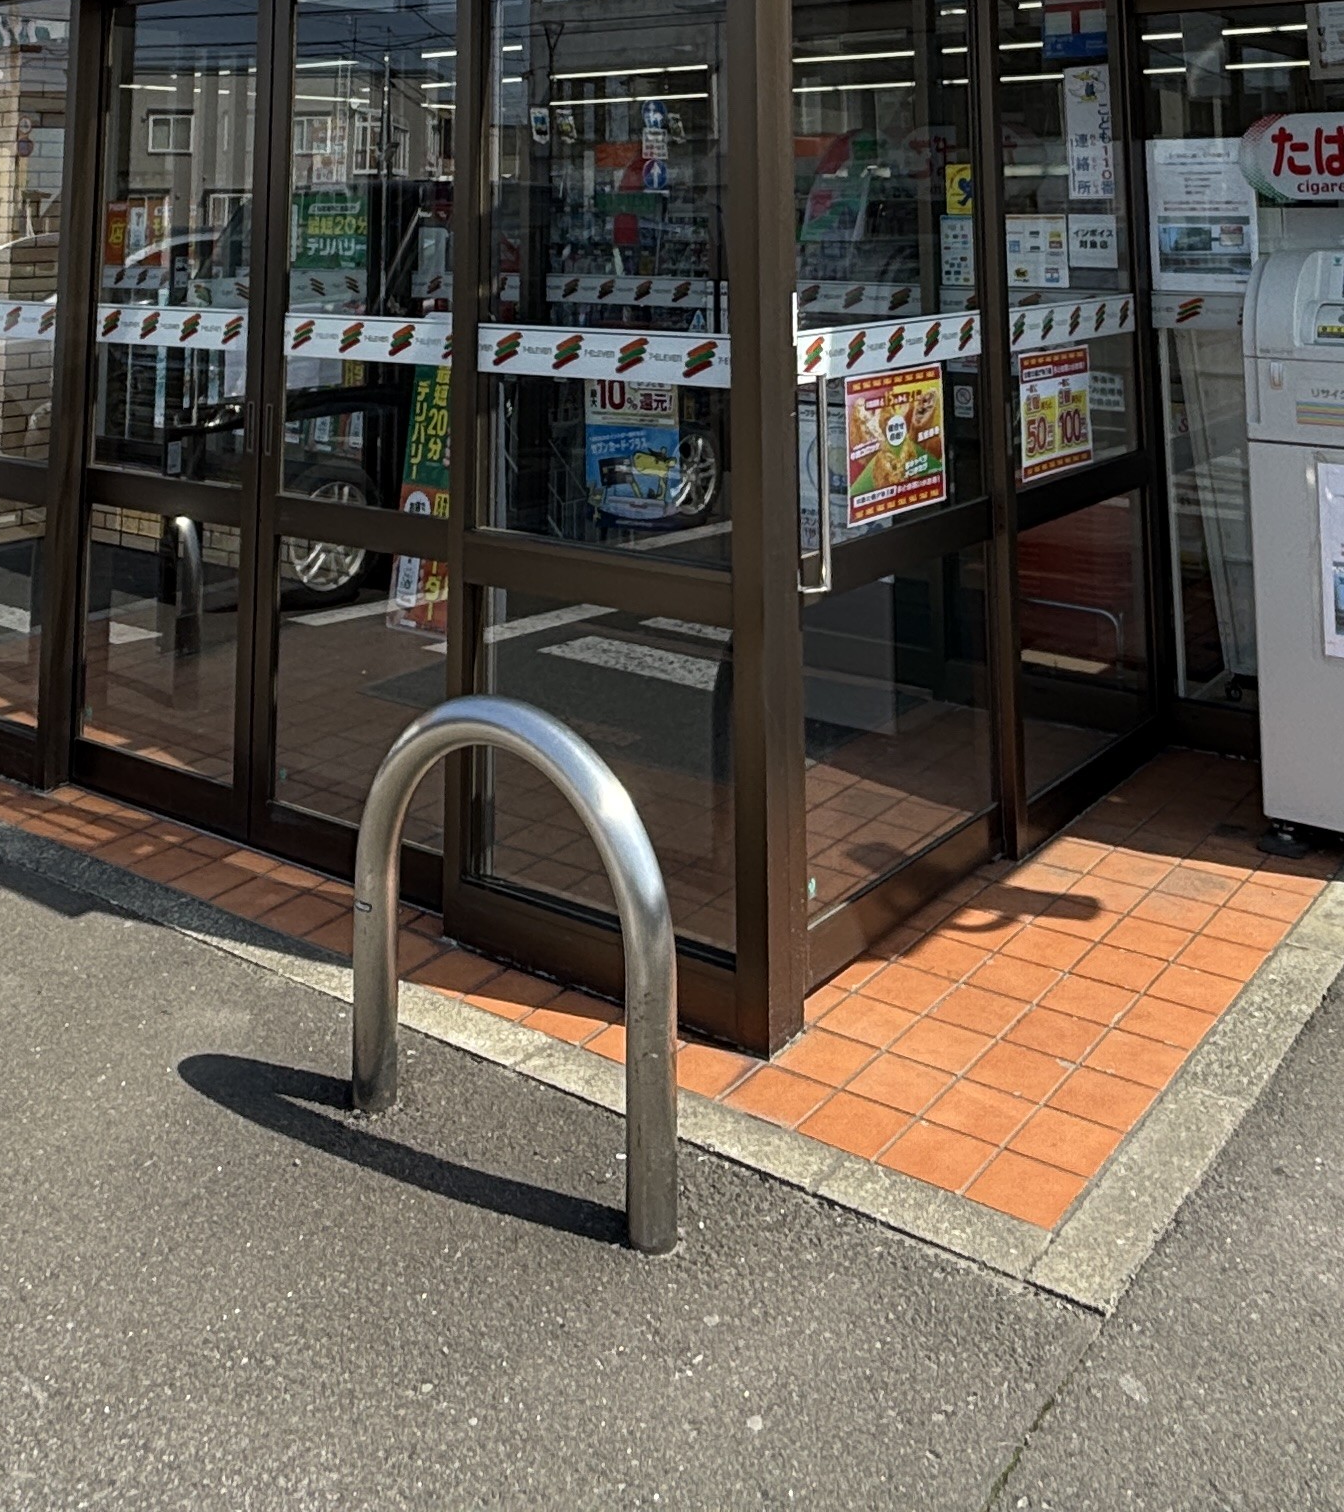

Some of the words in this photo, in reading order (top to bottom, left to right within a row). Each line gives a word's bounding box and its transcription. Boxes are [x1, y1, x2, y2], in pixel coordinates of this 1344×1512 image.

[1073, 228, 1114, 239] インボイス
[307, 237, 367, 256] デリバリー
[411, 380, 431, 480] デリバリー
